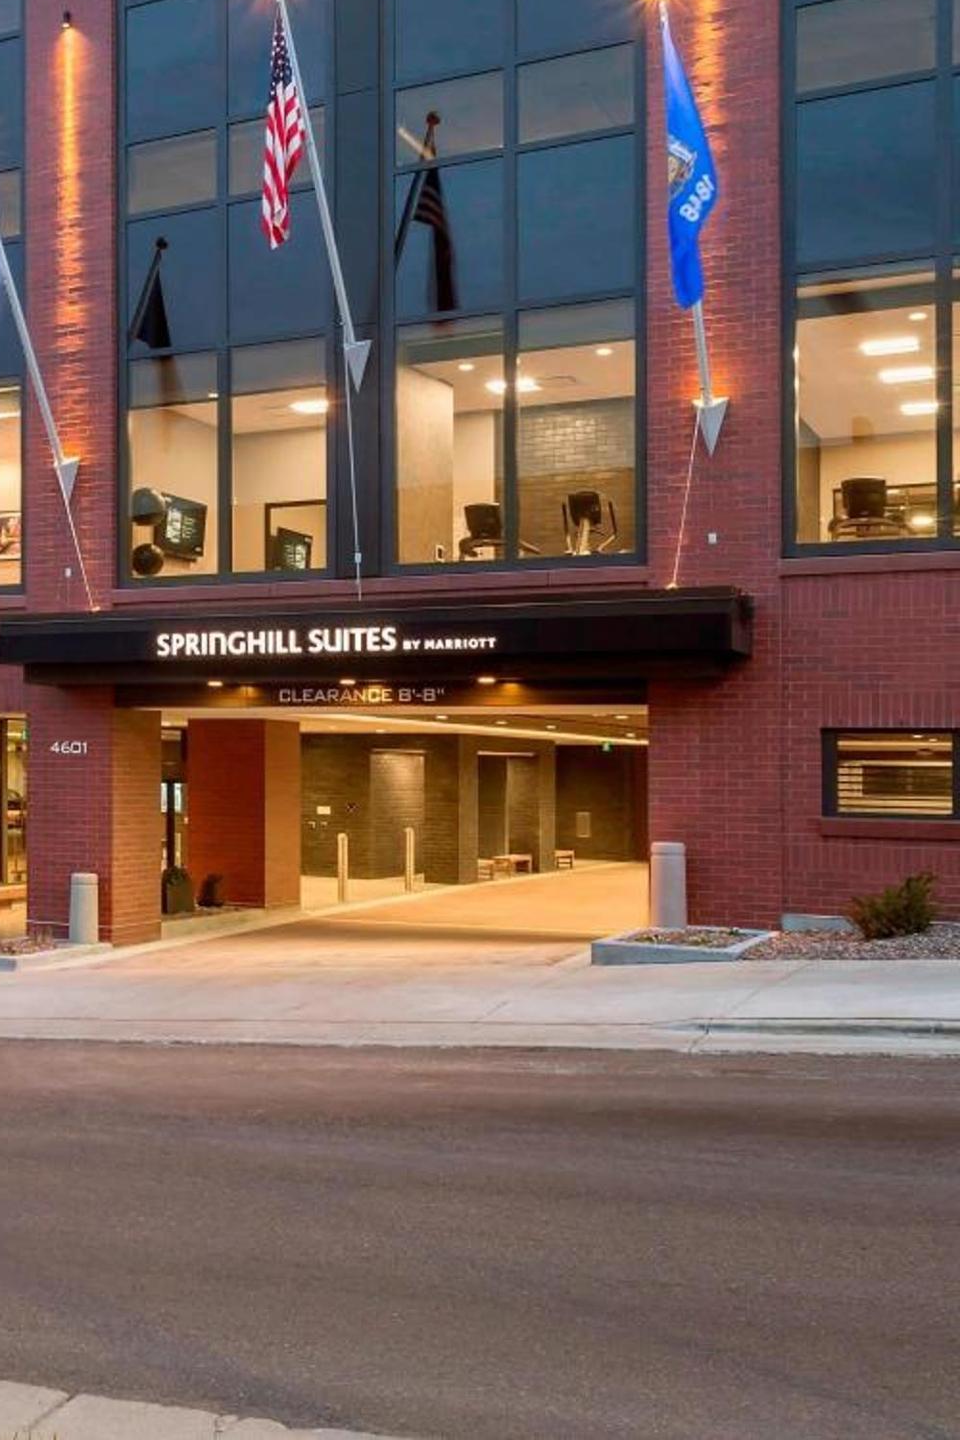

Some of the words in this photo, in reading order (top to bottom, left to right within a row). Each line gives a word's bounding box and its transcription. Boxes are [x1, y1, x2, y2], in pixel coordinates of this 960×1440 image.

[156, 630, 302, 656] SPRINGHILL
[308, 627, 397, 653] SUITES
[402, 639, 421, 650] BY
[424, 637, 496, 650] MARRIOTT
[279, 688, 393, 702] CLEARANCE
[50, 741, 87, 754] 4601
